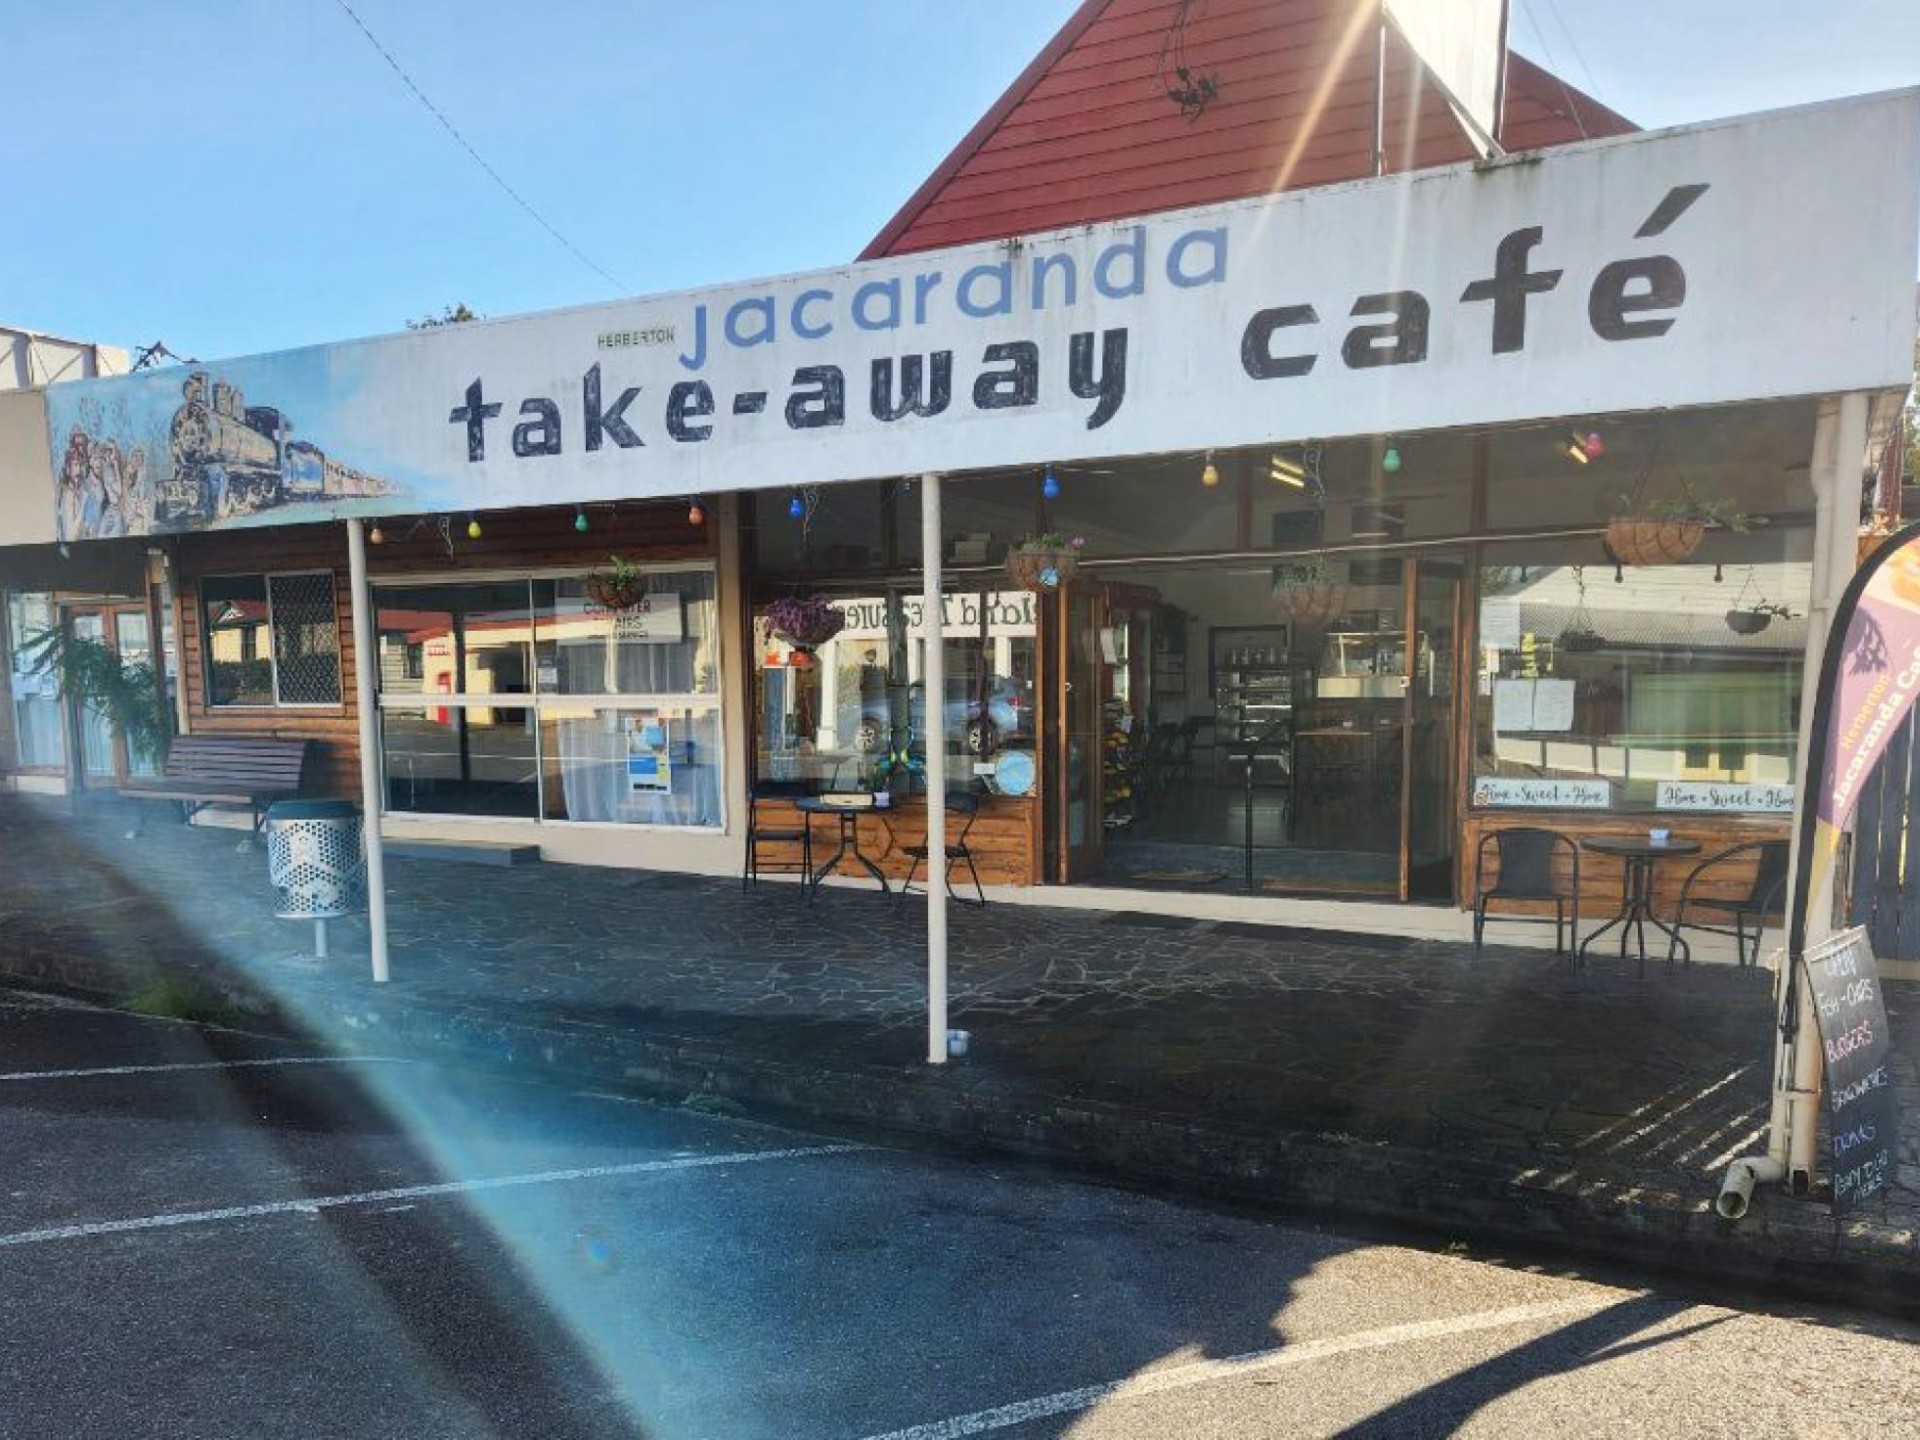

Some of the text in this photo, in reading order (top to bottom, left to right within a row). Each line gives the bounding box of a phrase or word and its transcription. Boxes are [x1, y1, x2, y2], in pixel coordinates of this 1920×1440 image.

[448, 183, 1712, 462] take-away café
[597, 325, 676, 350] HERBERTON
[1832, 691, 1905, 808] Jacaranda
